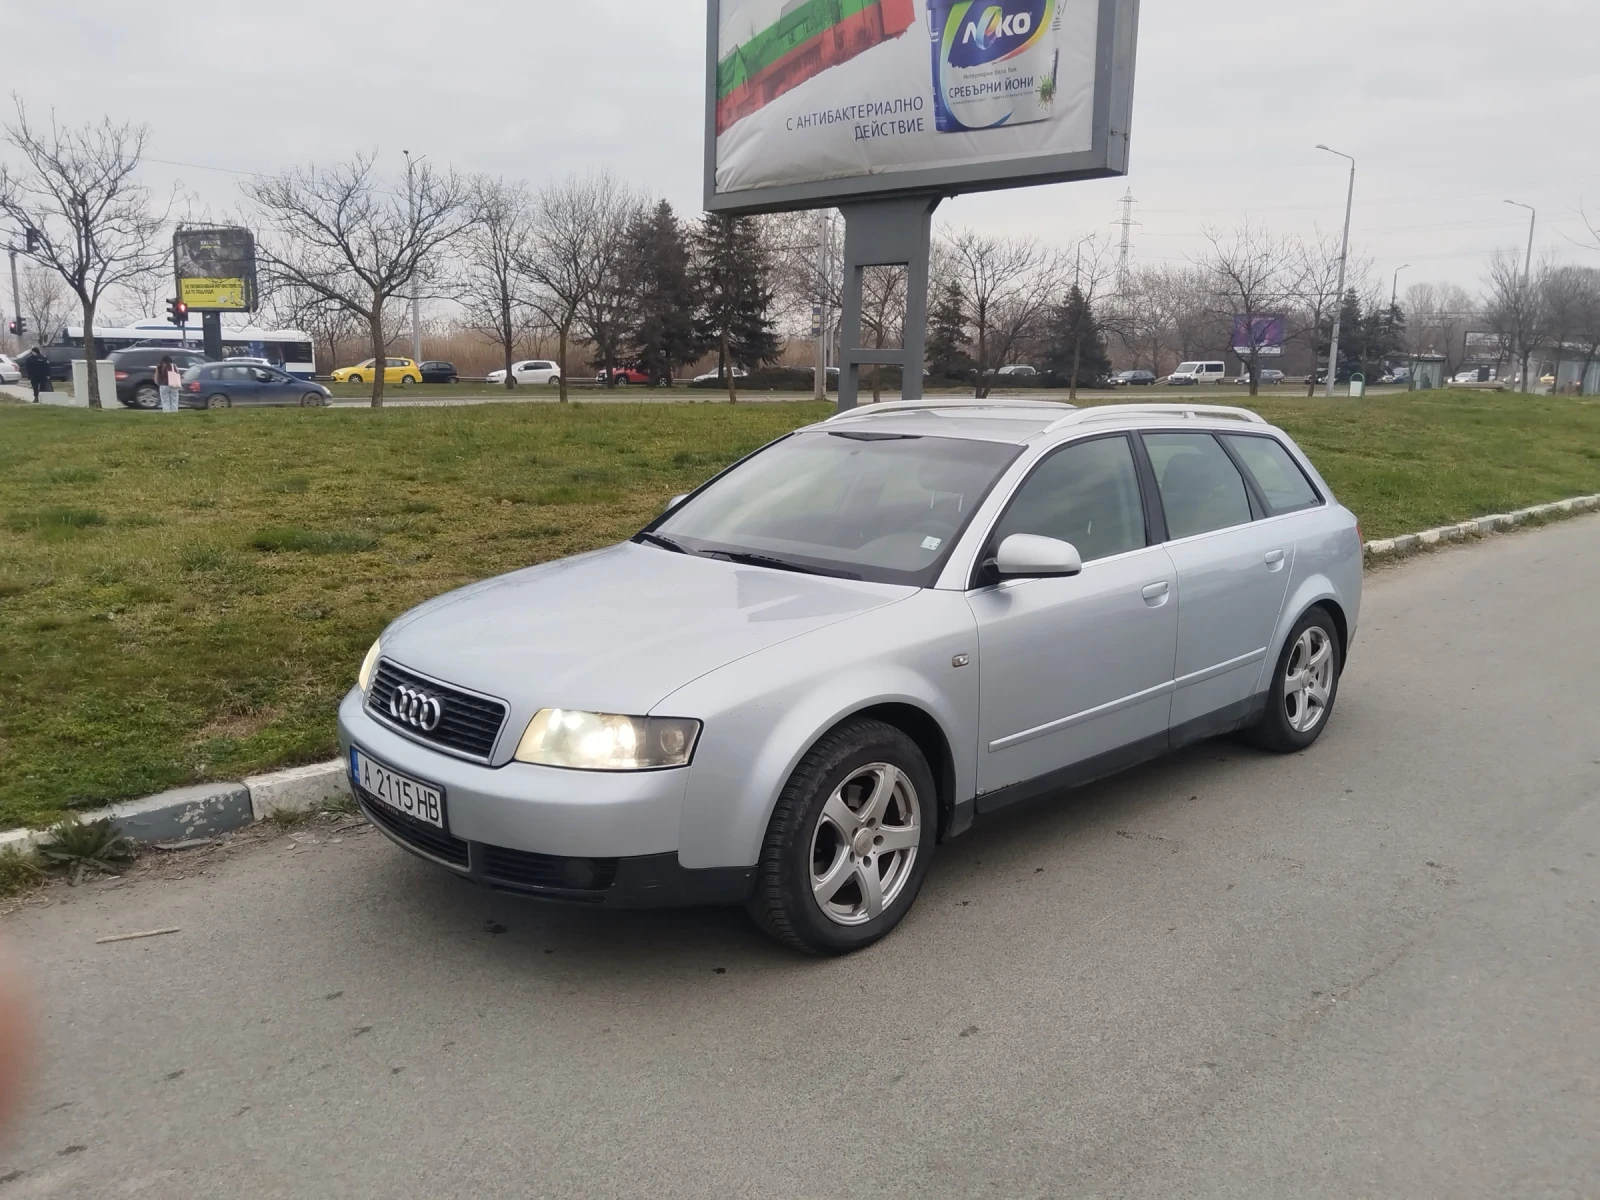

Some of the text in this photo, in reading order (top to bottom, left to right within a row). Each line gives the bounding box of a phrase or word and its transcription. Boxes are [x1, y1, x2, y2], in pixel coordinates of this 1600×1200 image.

[949, 80, 1002, 99] СРЕБЪРНИ
[1005, 76, 1034, 91] ЙОНИ
[786, 96, 924, 131] С АНТИБАКТЕРИАЛНО
[854, 117, 925, 142] ДЕЙСТВИЕ
[364, 760, 372, 789] A
[376, 768, 414, 811] 2115
[416, 786, 439, 823] HB
